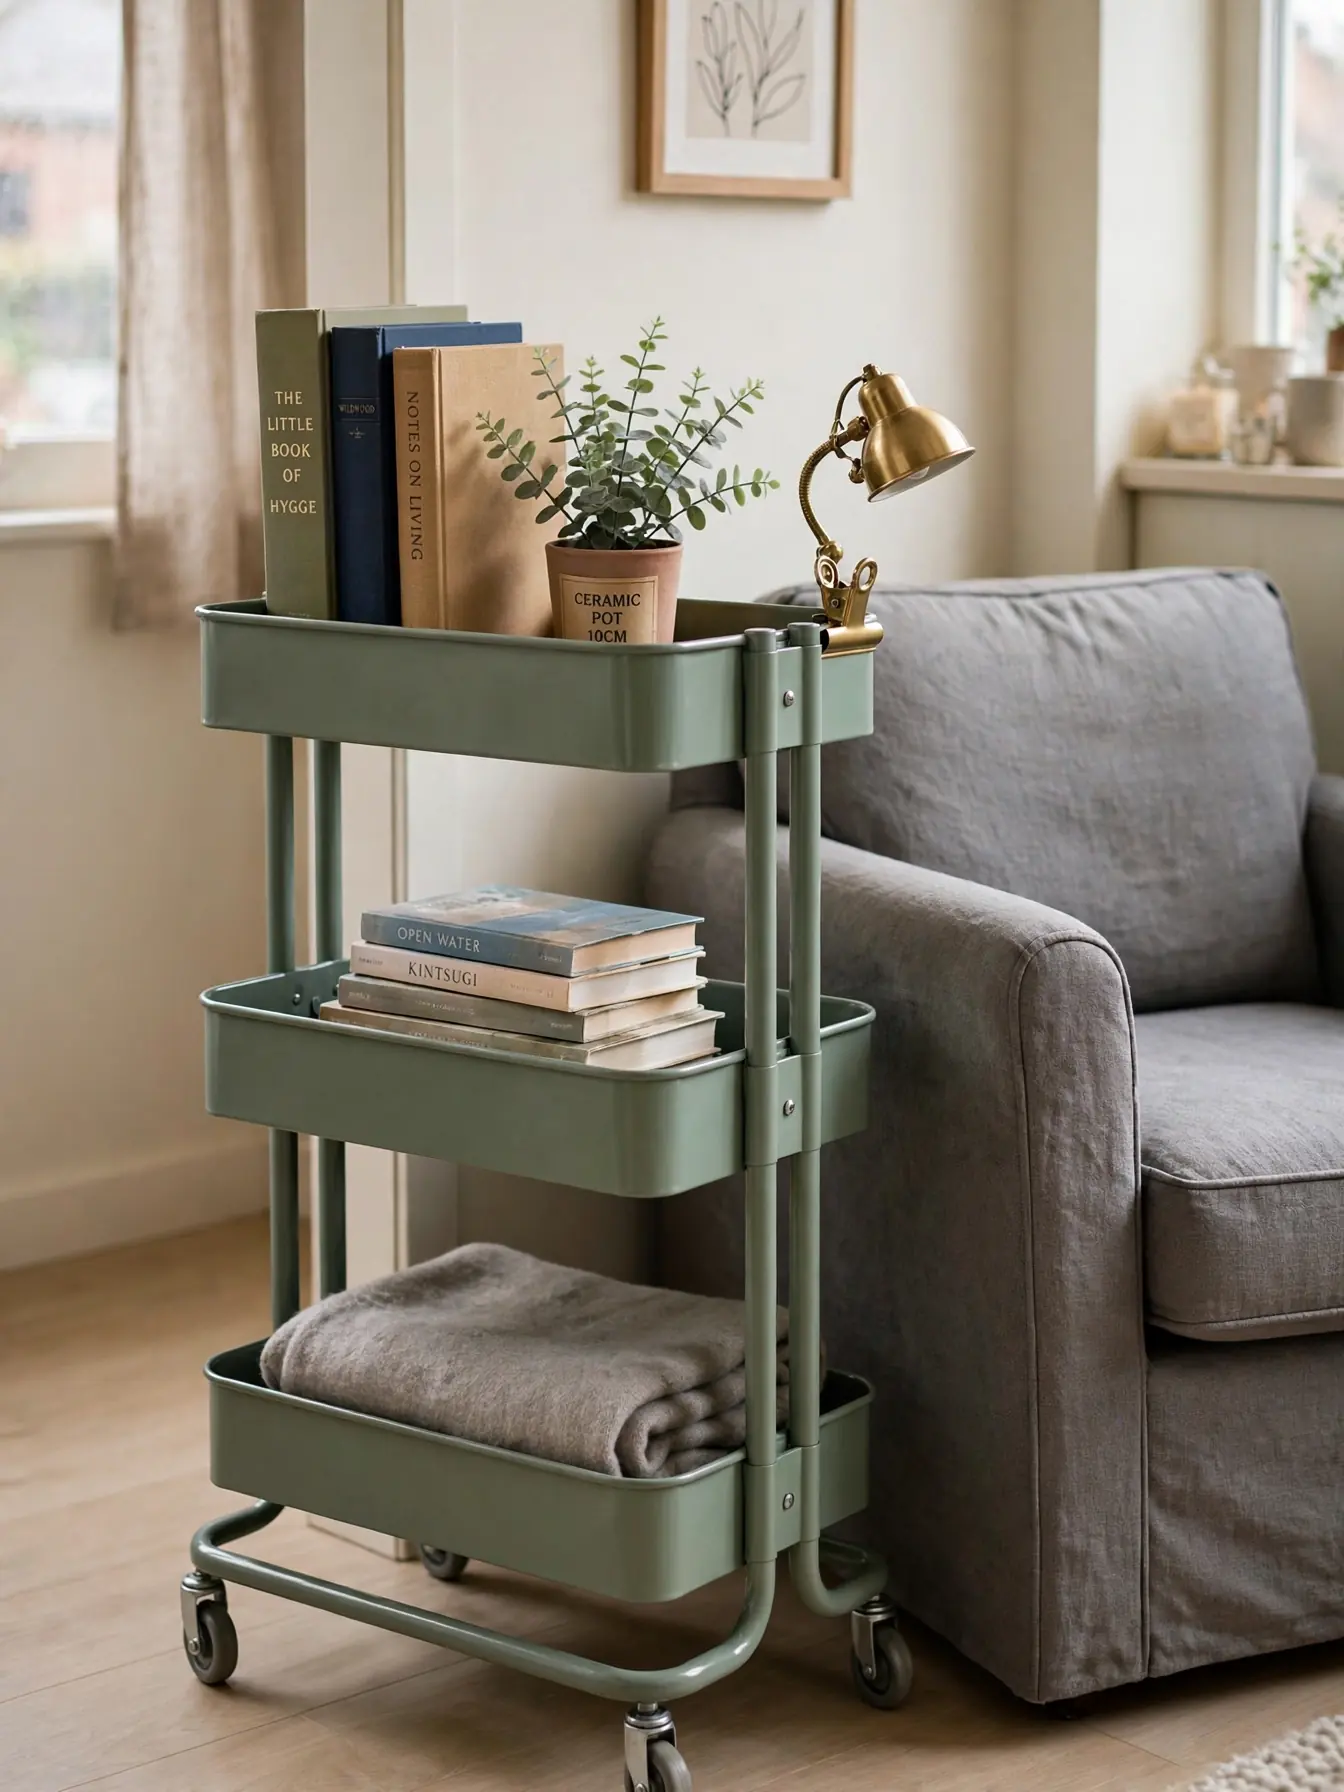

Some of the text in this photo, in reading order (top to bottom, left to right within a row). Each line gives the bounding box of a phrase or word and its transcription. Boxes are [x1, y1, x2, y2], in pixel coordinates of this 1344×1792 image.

[274, 391, 303, 405] THE
[267, 417, 314, 431] LITTLE
[271, 443, 311, 458] BOOK
[282, 468, 301, 483] OF
[407, 391, 423, 560] NOTES ON LIVING
[270, 499, 317, 514] HYGGE
[574, 592, 641, 607] CERAMIC
[592, 612, 623, 625] POT
[588, 630, 627, 643] 10CM
[397, 926, 480, 953] OPEN WATER
[408, 961, 477, 987] KINTSUGI
